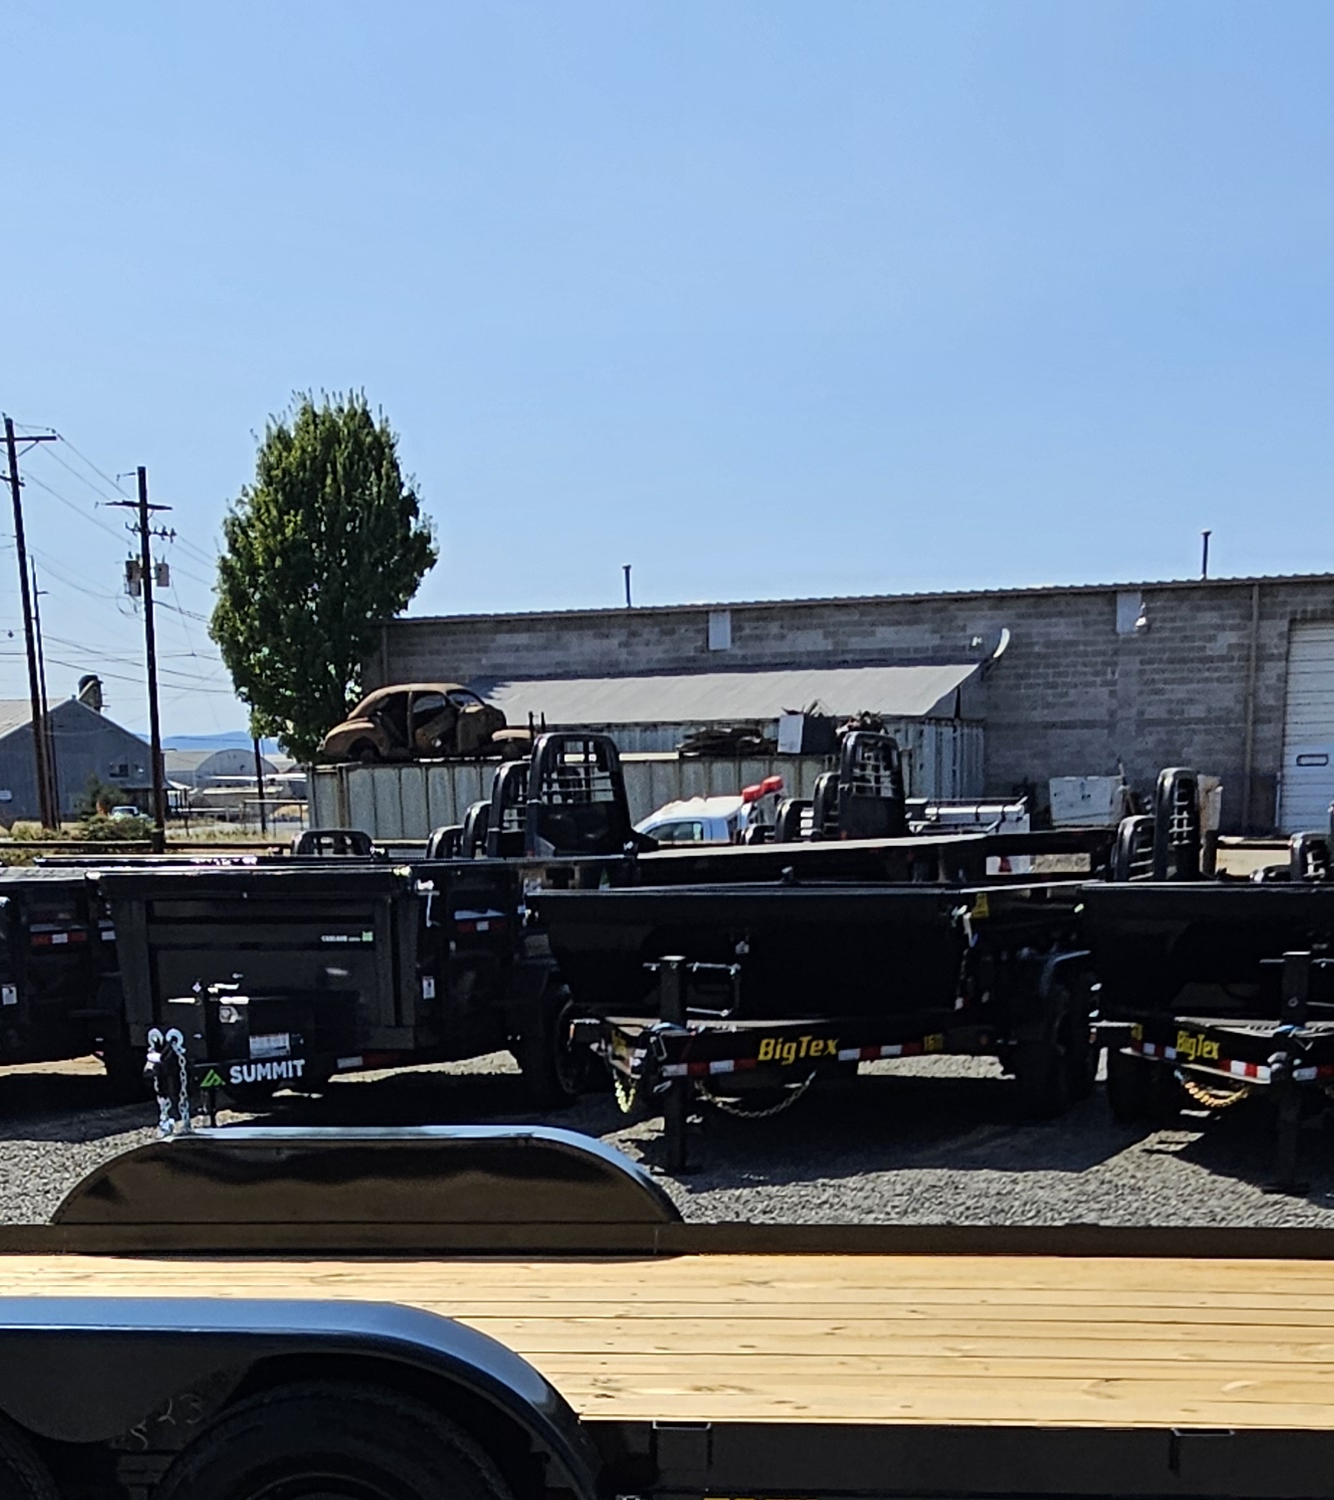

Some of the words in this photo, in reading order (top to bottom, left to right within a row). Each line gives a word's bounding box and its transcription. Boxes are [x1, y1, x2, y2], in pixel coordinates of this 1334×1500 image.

[756, 1037, 839, 1064] BigTex
[1176, 1030, 1220, 1061] BigTex
[229, 1058, 306, 1084] SUMMIT
